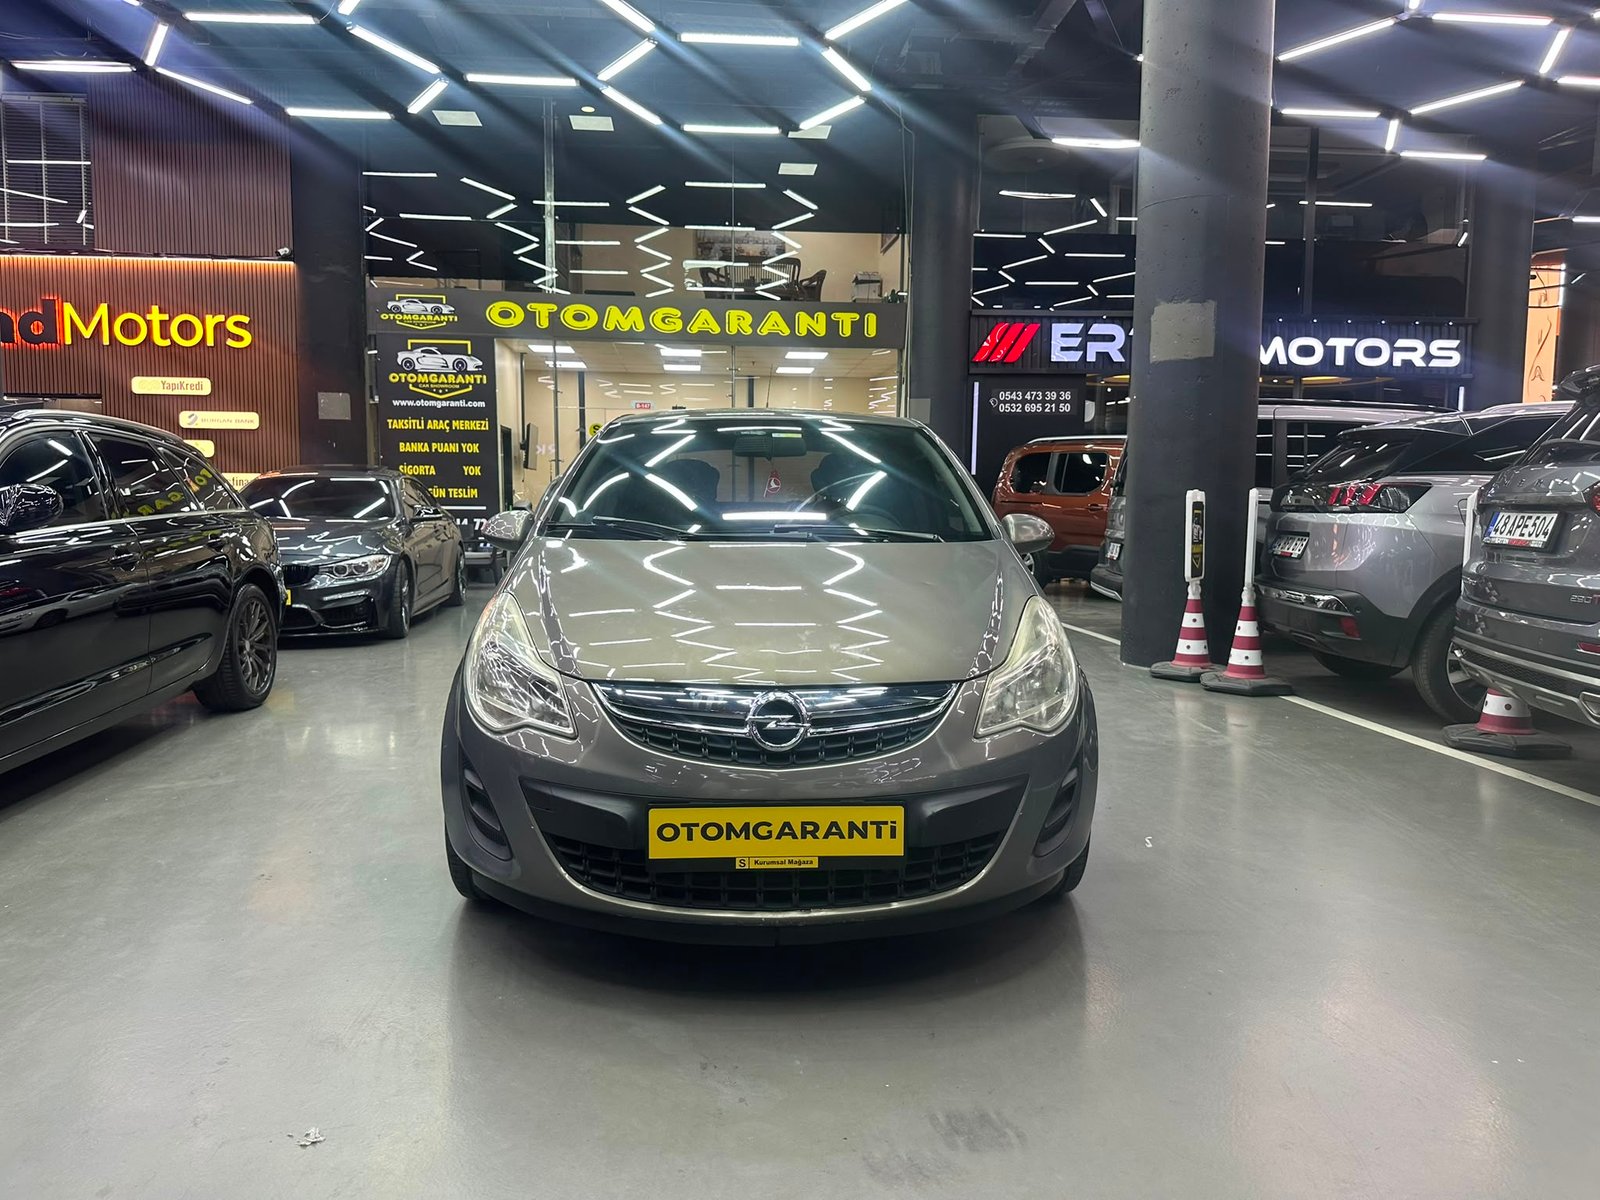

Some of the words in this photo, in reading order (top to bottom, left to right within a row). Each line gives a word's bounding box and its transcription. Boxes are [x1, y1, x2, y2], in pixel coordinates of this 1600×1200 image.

[485, 300, 877, 338] OTOMGARANTI
[1050, 323, 1133, 362] ER
[1259, 336, 1461, 367] MOTORS
[389, 372, 487, 384] OTOMGARANTI
[999, 391, 1022, 400] 0543
[1024, 391, 1042, 400] 473
[1044, 392, 1057, 400] 39
[1059, 392, 1072, 400] 36
[392, 400, 486, 408] www.otomgaranti.com
[998, 403, 1022, 412] 0532
[1024, 403, 1042, 412] 695
[1044, 403, 1056, 412] 21
[1058, 403, 1071, 412] 50
[387, 416, 424, 430] TAKSİTLİ
[427, 419, 450, 432] ARAÇ
[452, 418, 489, 431] MERKEZİ
[399, 442, 430, 453] BANKA
[432, 442, 459, 453] PUANI
[461, 443, 480, 453] YOK
[399, 462, 436, 476] SİGORTA
[463, 466, 482, 476] YOK
[448, 486, 478, 498] TESLİM
[1494, 514, 1510, 536] 48
[1508, 515, 1532, 537] APE
[1528, 516, 1554, 538] 504
[788, 859, 814, 867] Mağaza
